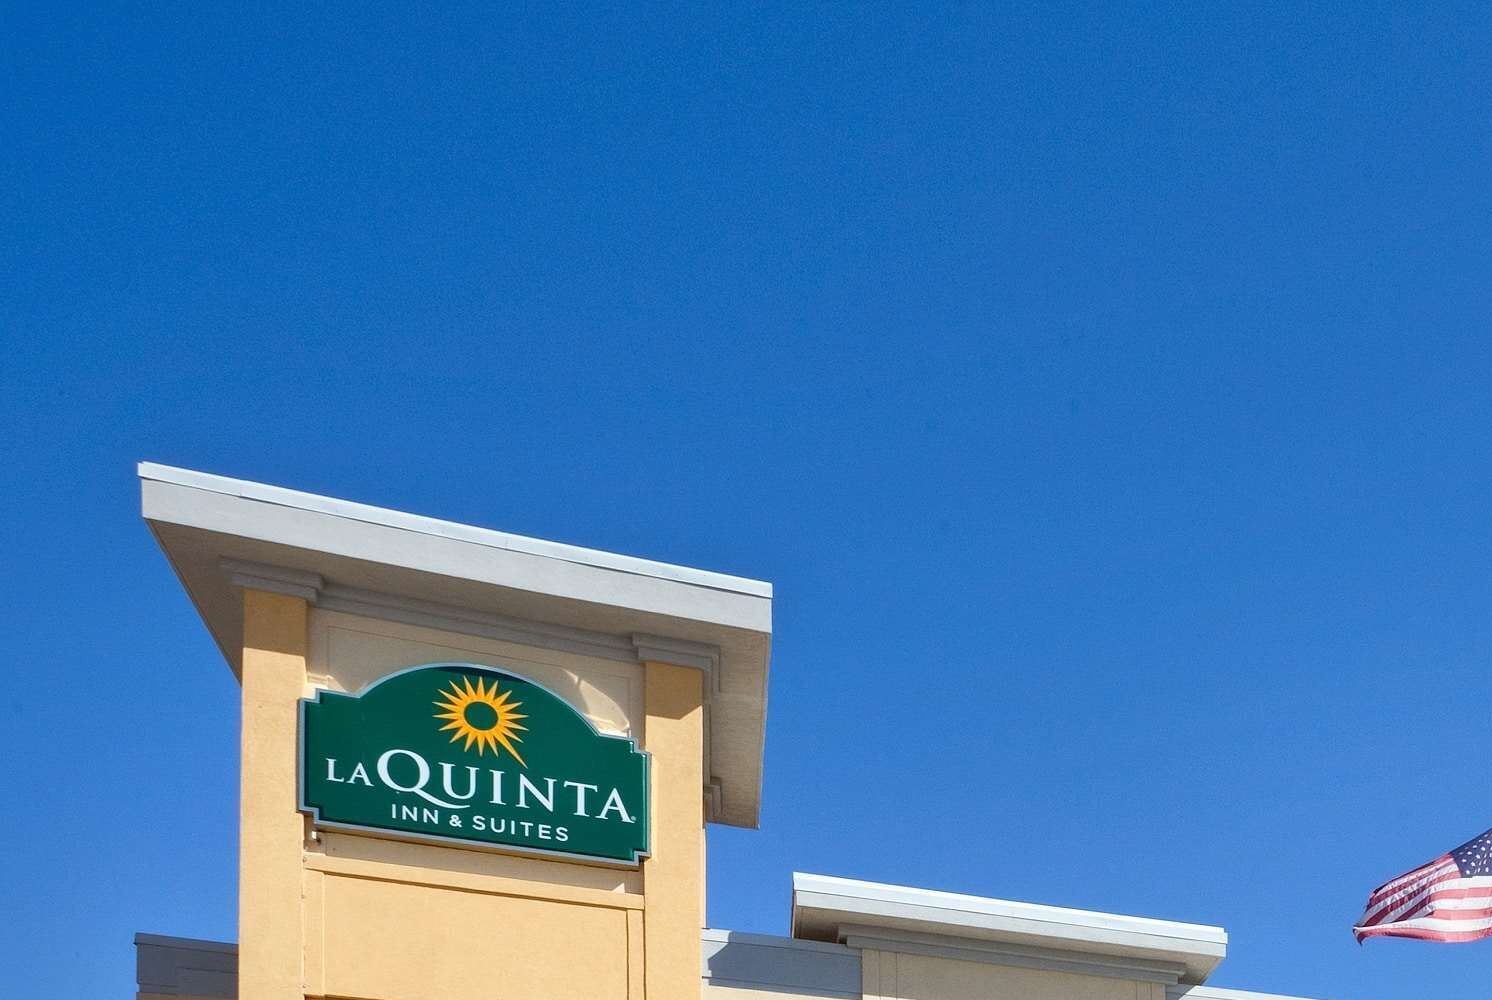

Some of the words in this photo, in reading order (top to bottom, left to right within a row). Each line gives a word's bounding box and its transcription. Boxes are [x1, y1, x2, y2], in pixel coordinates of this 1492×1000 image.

[326, 758, 375, 787] LA
[376, 749, 635, 824] QUINTA
[391, 803, 439, 825] INN
[449, 814, 462, 828] &
[472, 815, 569, 842] SUITES
